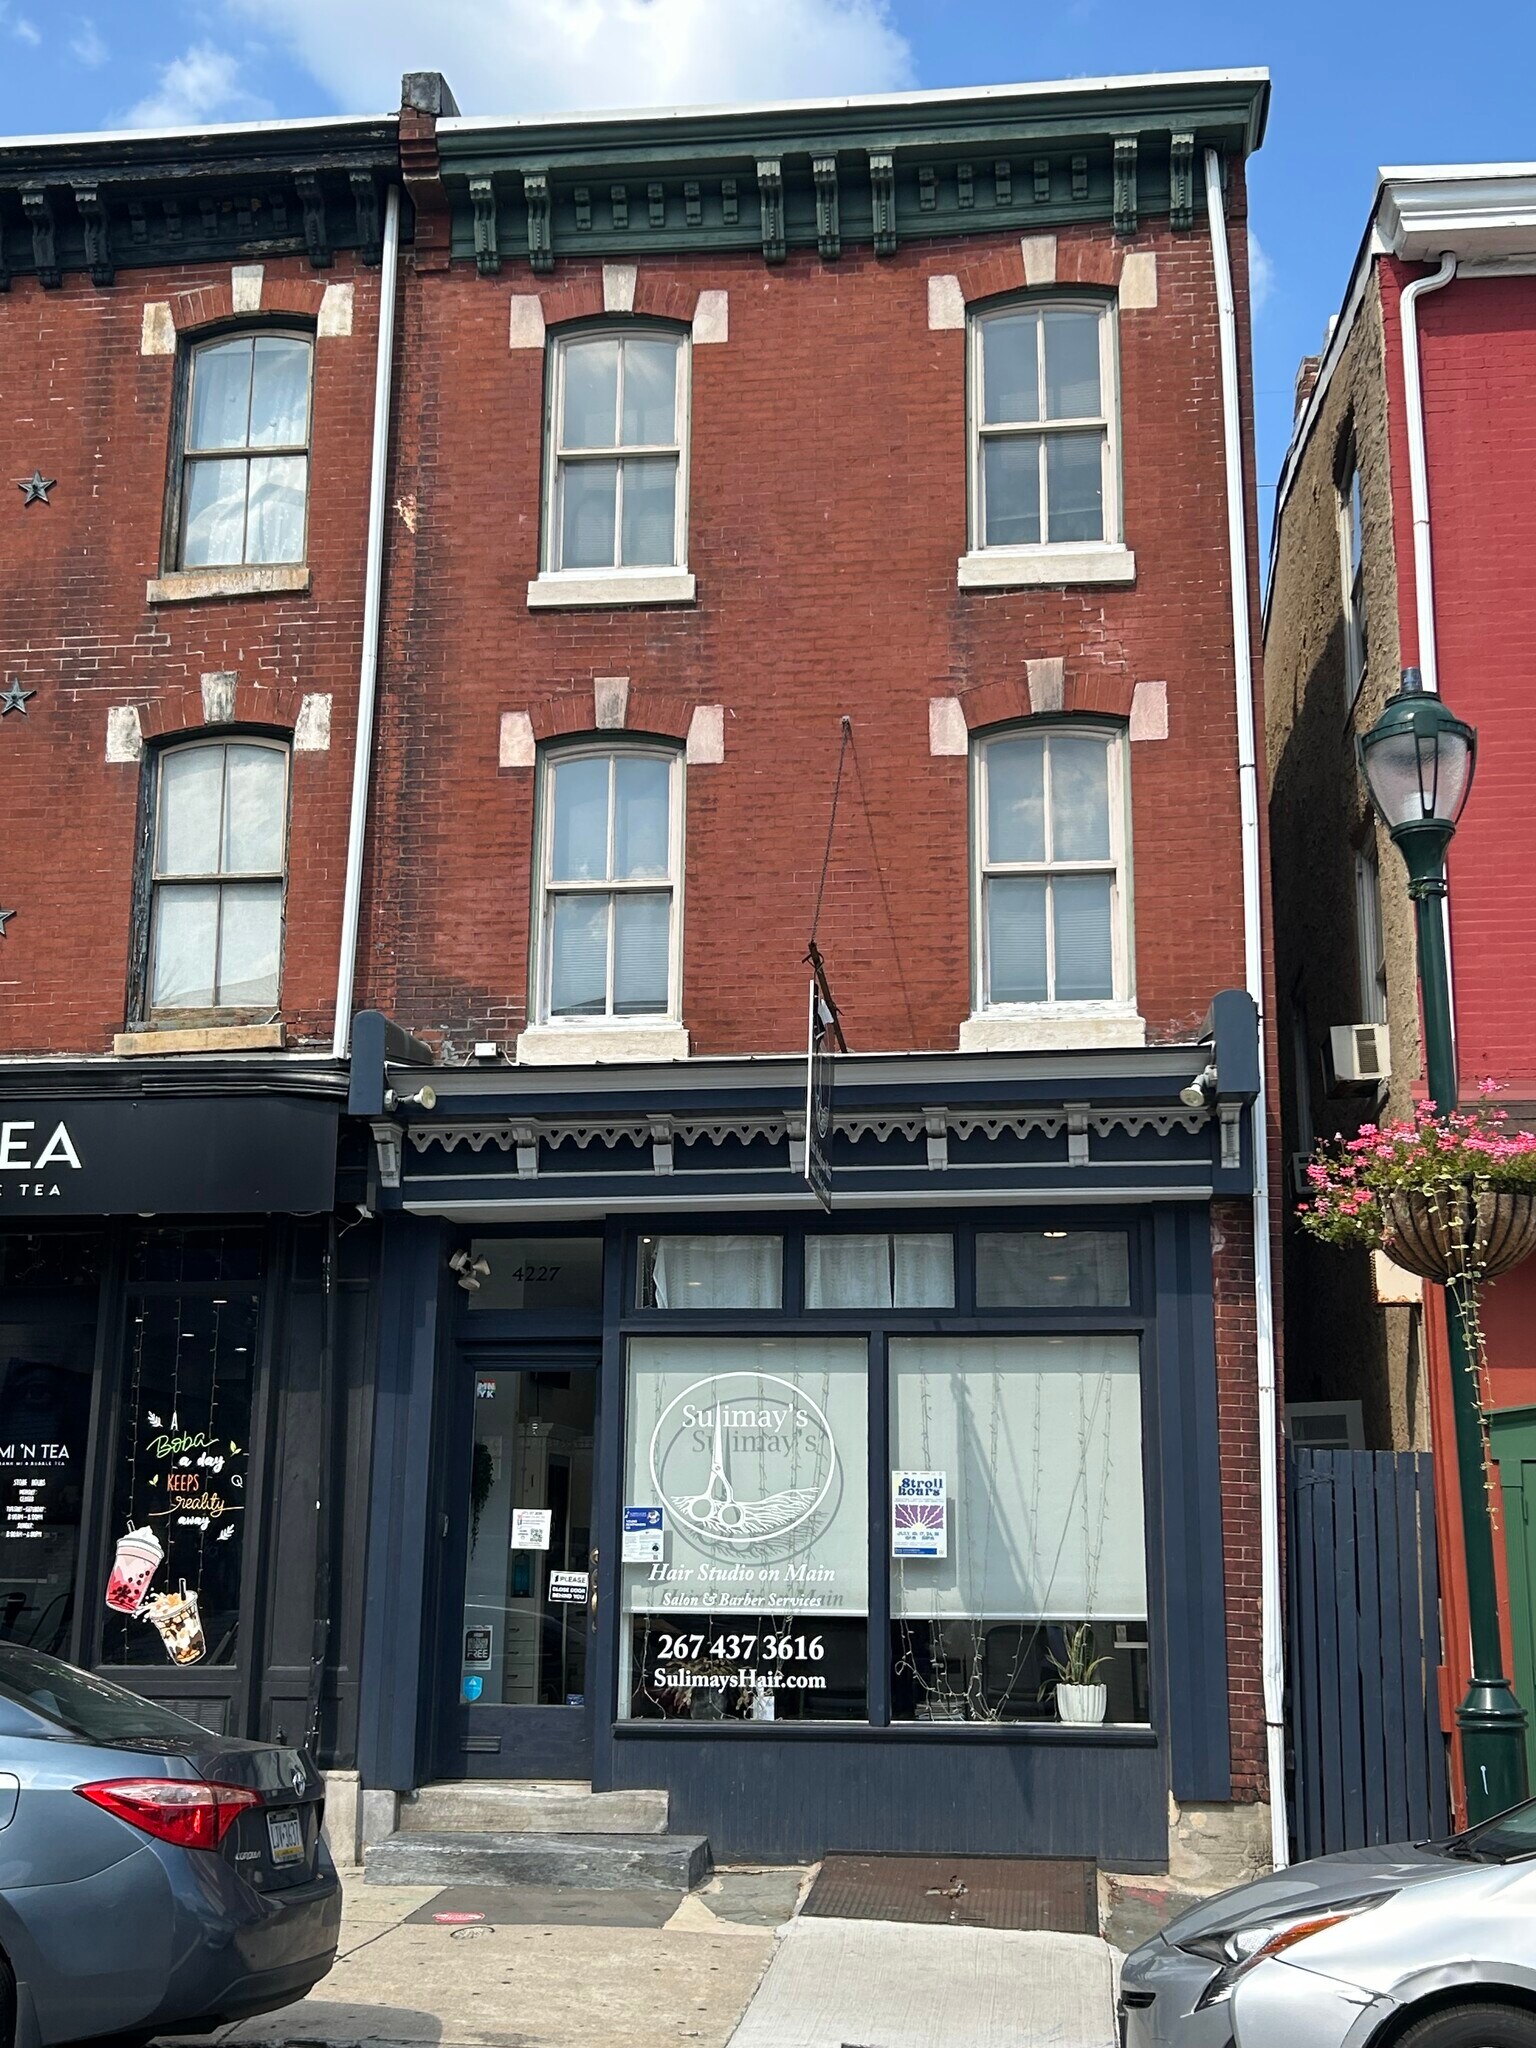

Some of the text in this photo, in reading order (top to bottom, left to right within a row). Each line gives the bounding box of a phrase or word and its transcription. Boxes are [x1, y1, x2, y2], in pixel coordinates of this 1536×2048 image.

[0, 1121, 82, 1169] EA
[19, 1183, 61, 1196] TEA
[512, 1266, 561, 1281] 4227
[170, 1411, 179, 1431] A
[682, 1402, 808, 1432] Sulimay's
[40, 1444, 70, 1459] TEA
[146, 1430, 219, 1458] Boba
[178, 1452, 225, 1473] a day
[167, 1474, 199, 1491] KEEPS
[177, 1516, 211, 1531] away
[648, 1563, 835, 1582] Hair Studio on Main
[662, 1593, 822, 1607] Salon & Barber Services
[657, 1635, 825, 1660] 267 437 3616
[654, 1667, 827, 1693] SulimaysHair.com
